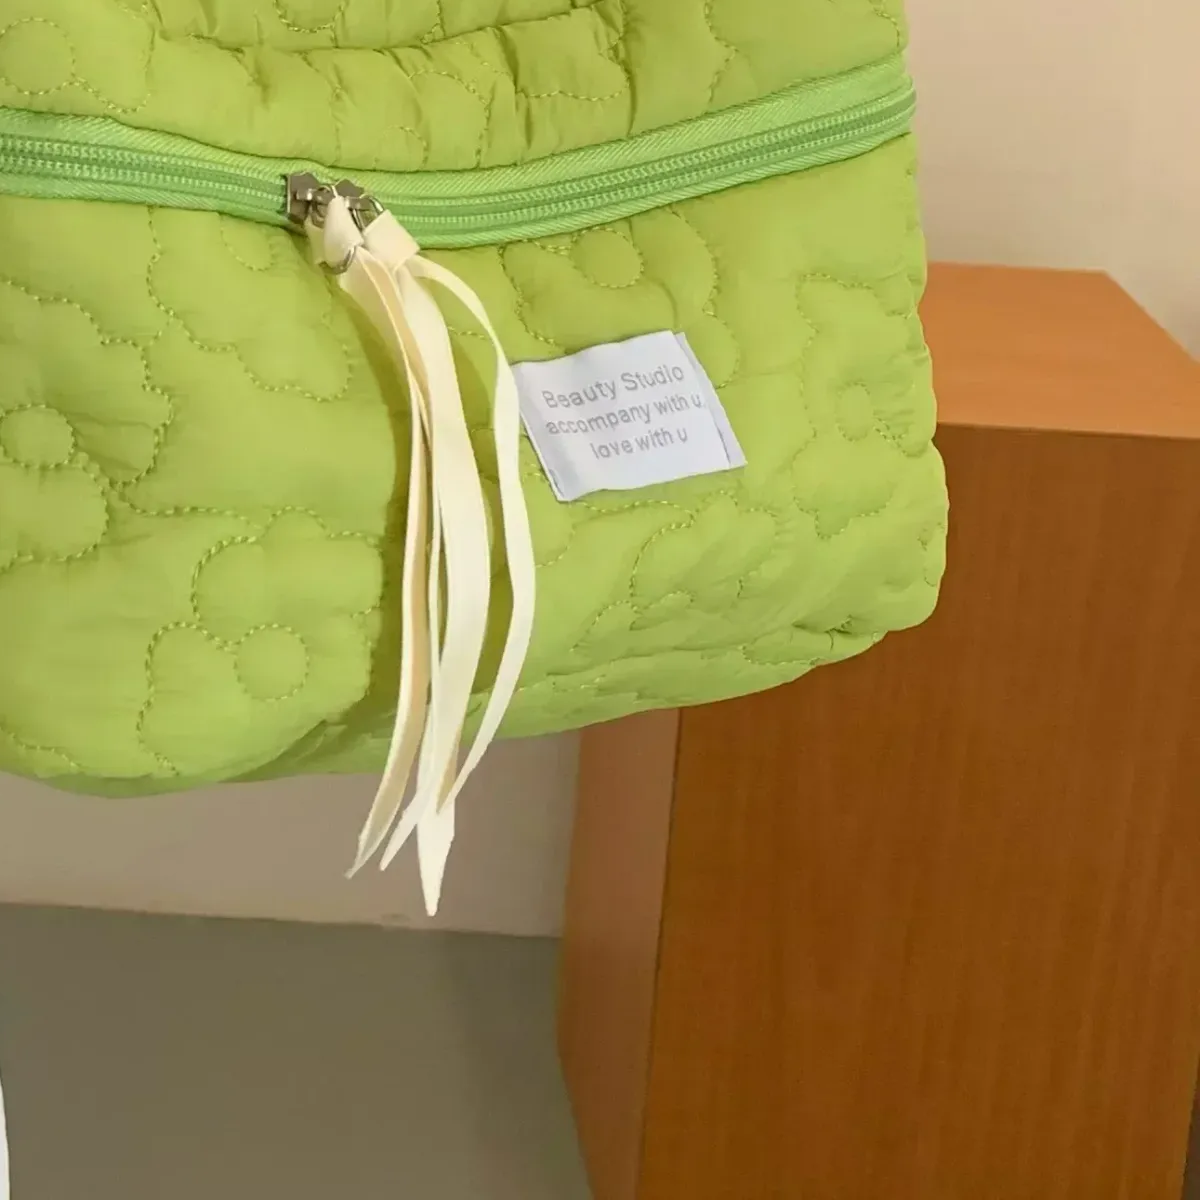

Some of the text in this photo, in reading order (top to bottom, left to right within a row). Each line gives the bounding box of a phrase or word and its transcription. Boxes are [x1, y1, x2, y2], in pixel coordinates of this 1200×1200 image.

[542, 364, 684, 408] Beauty Studio
[546, 394, 701, 434] accompany with u
[590, 428, 688, 460] love with u
